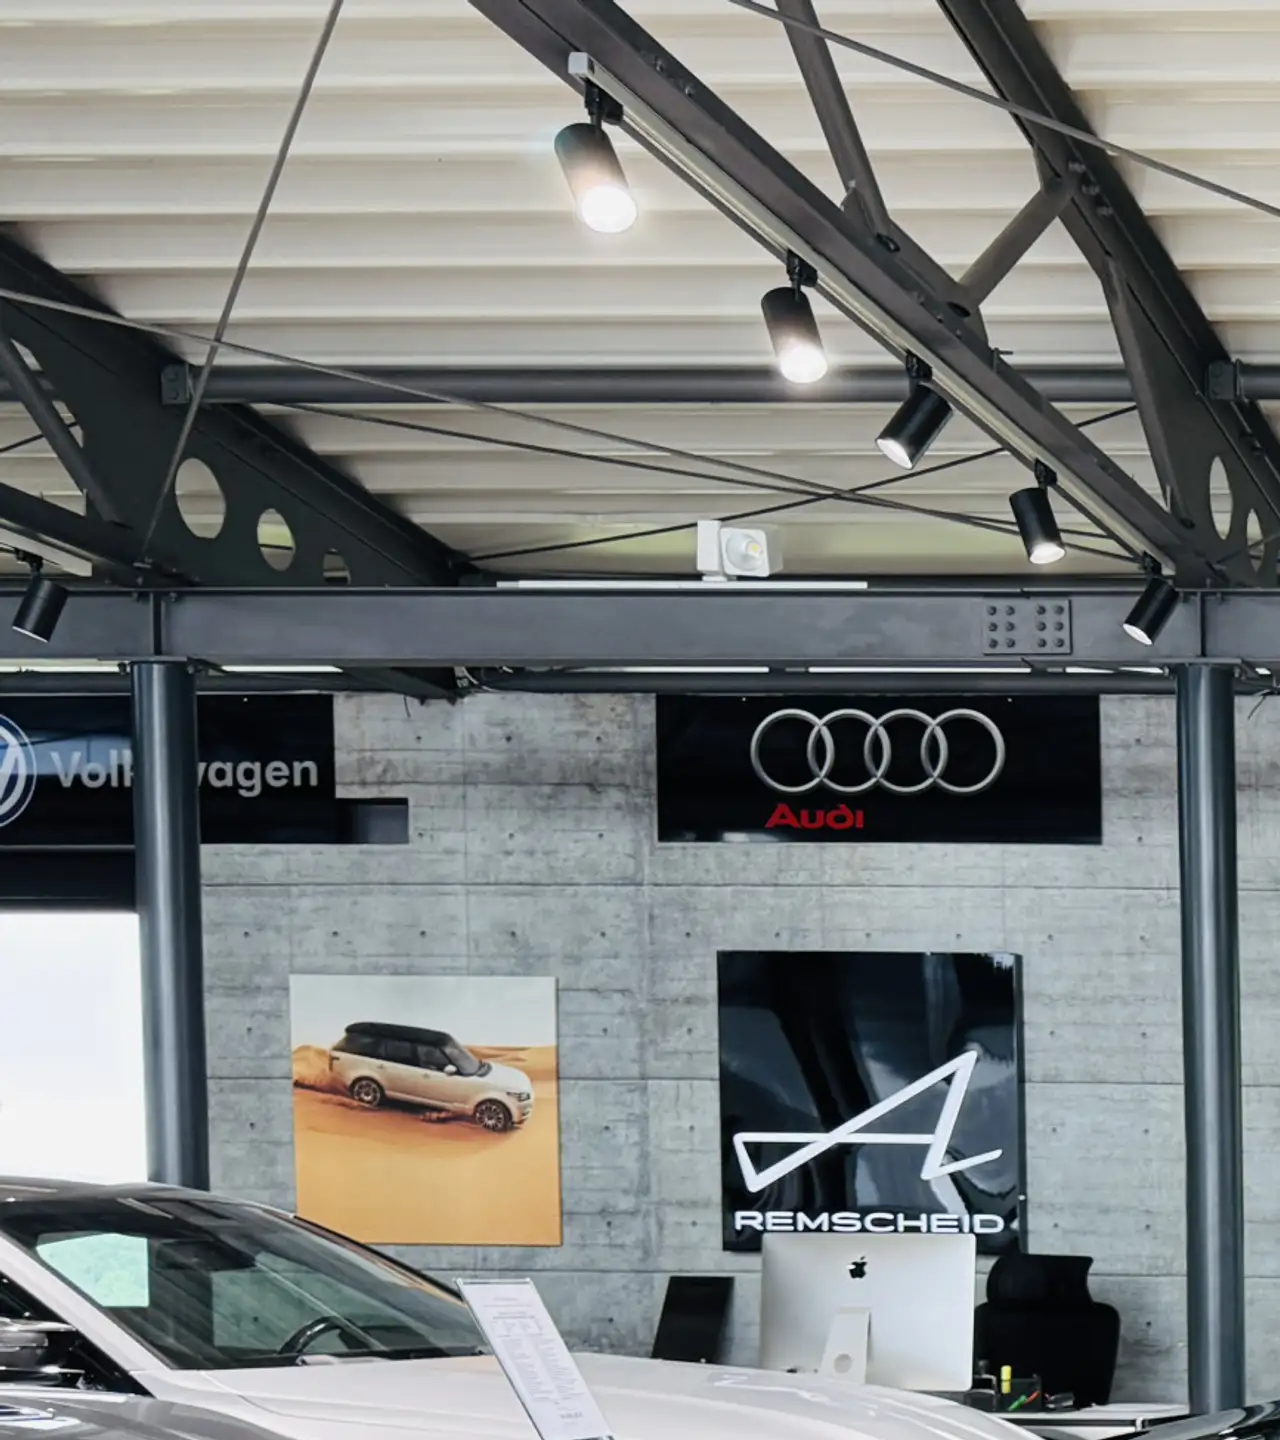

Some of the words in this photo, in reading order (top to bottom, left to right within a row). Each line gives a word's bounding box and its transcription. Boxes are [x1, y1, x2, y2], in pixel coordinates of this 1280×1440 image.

[50, 749, 319, 798] Volagen
[764, 803, 866, 829] Audi
[733, 1210, 1006, 1234] REMSCHEID
